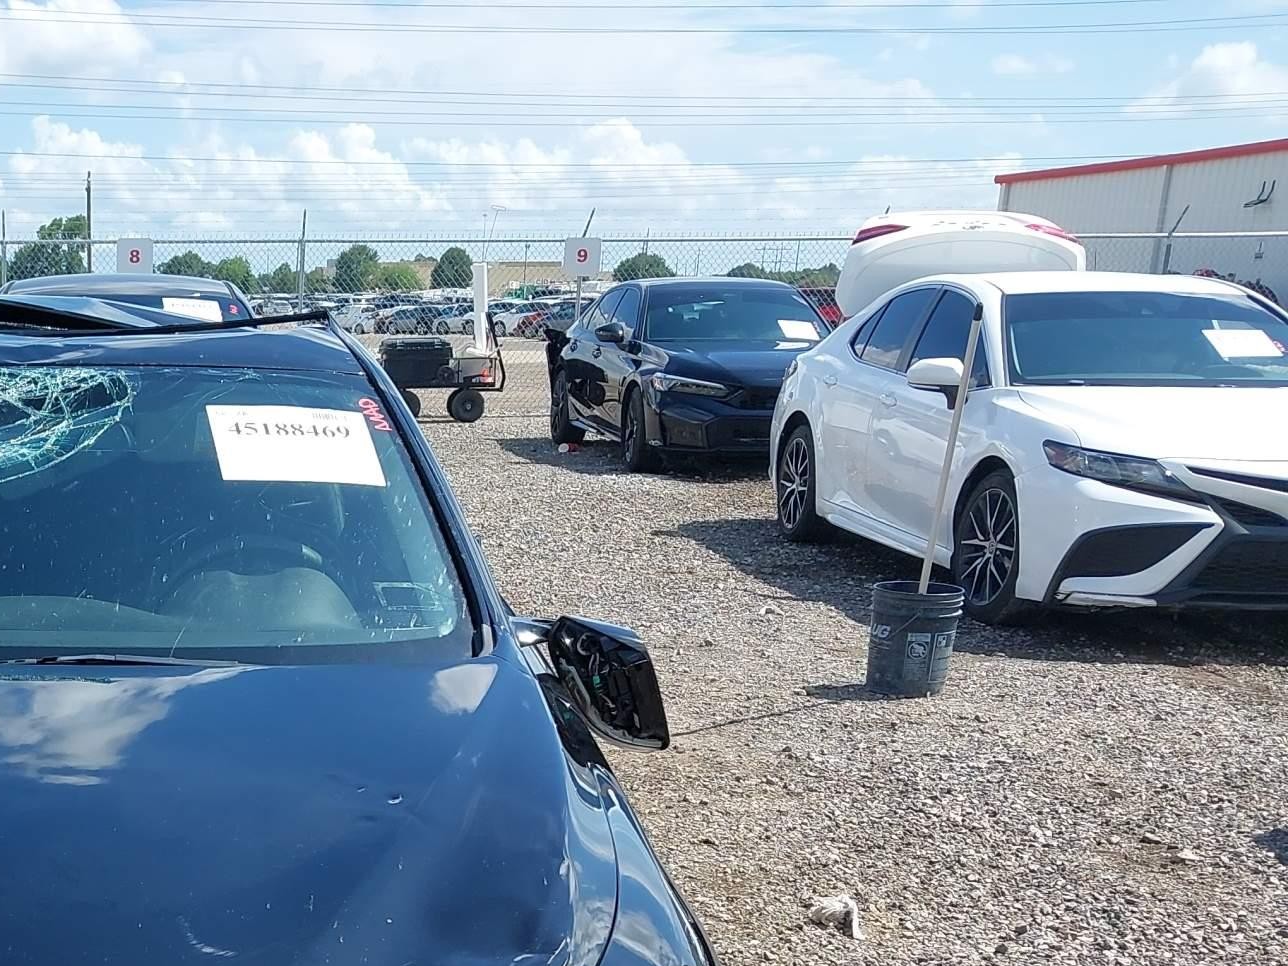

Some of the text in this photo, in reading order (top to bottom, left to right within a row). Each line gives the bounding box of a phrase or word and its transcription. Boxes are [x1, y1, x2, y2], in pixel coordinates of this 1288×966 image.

[129, 249, 140, 263] 8
[577, 248, 588, 263] 9
[228, 422, 350, 438] 45188469
